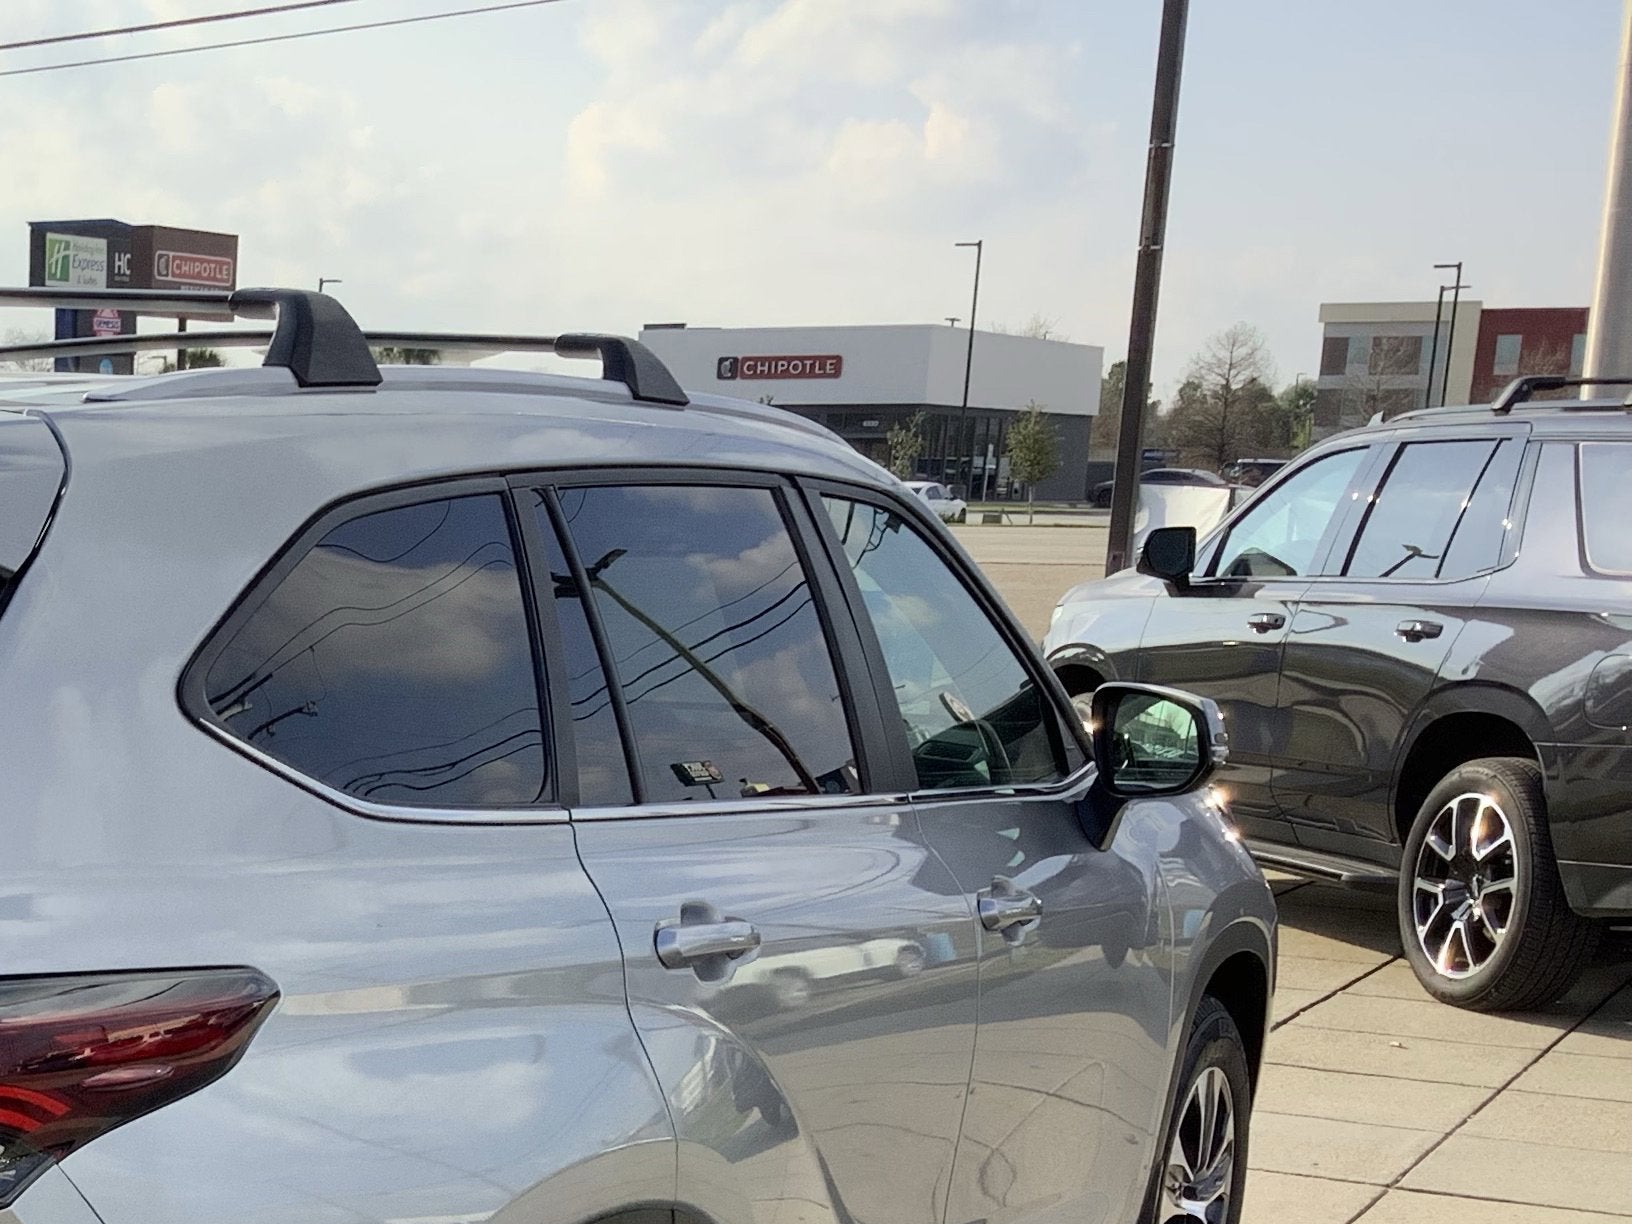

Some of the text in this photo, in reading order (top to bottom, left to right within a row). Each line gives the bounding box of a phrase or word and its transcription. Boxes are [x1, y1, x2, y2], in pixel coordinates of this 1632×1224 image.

[72, 254, 105, 272] Express
[173, 259, 229, 279] CHIPOTLE
[743, 360, 836, 375] CHIPOTLE
